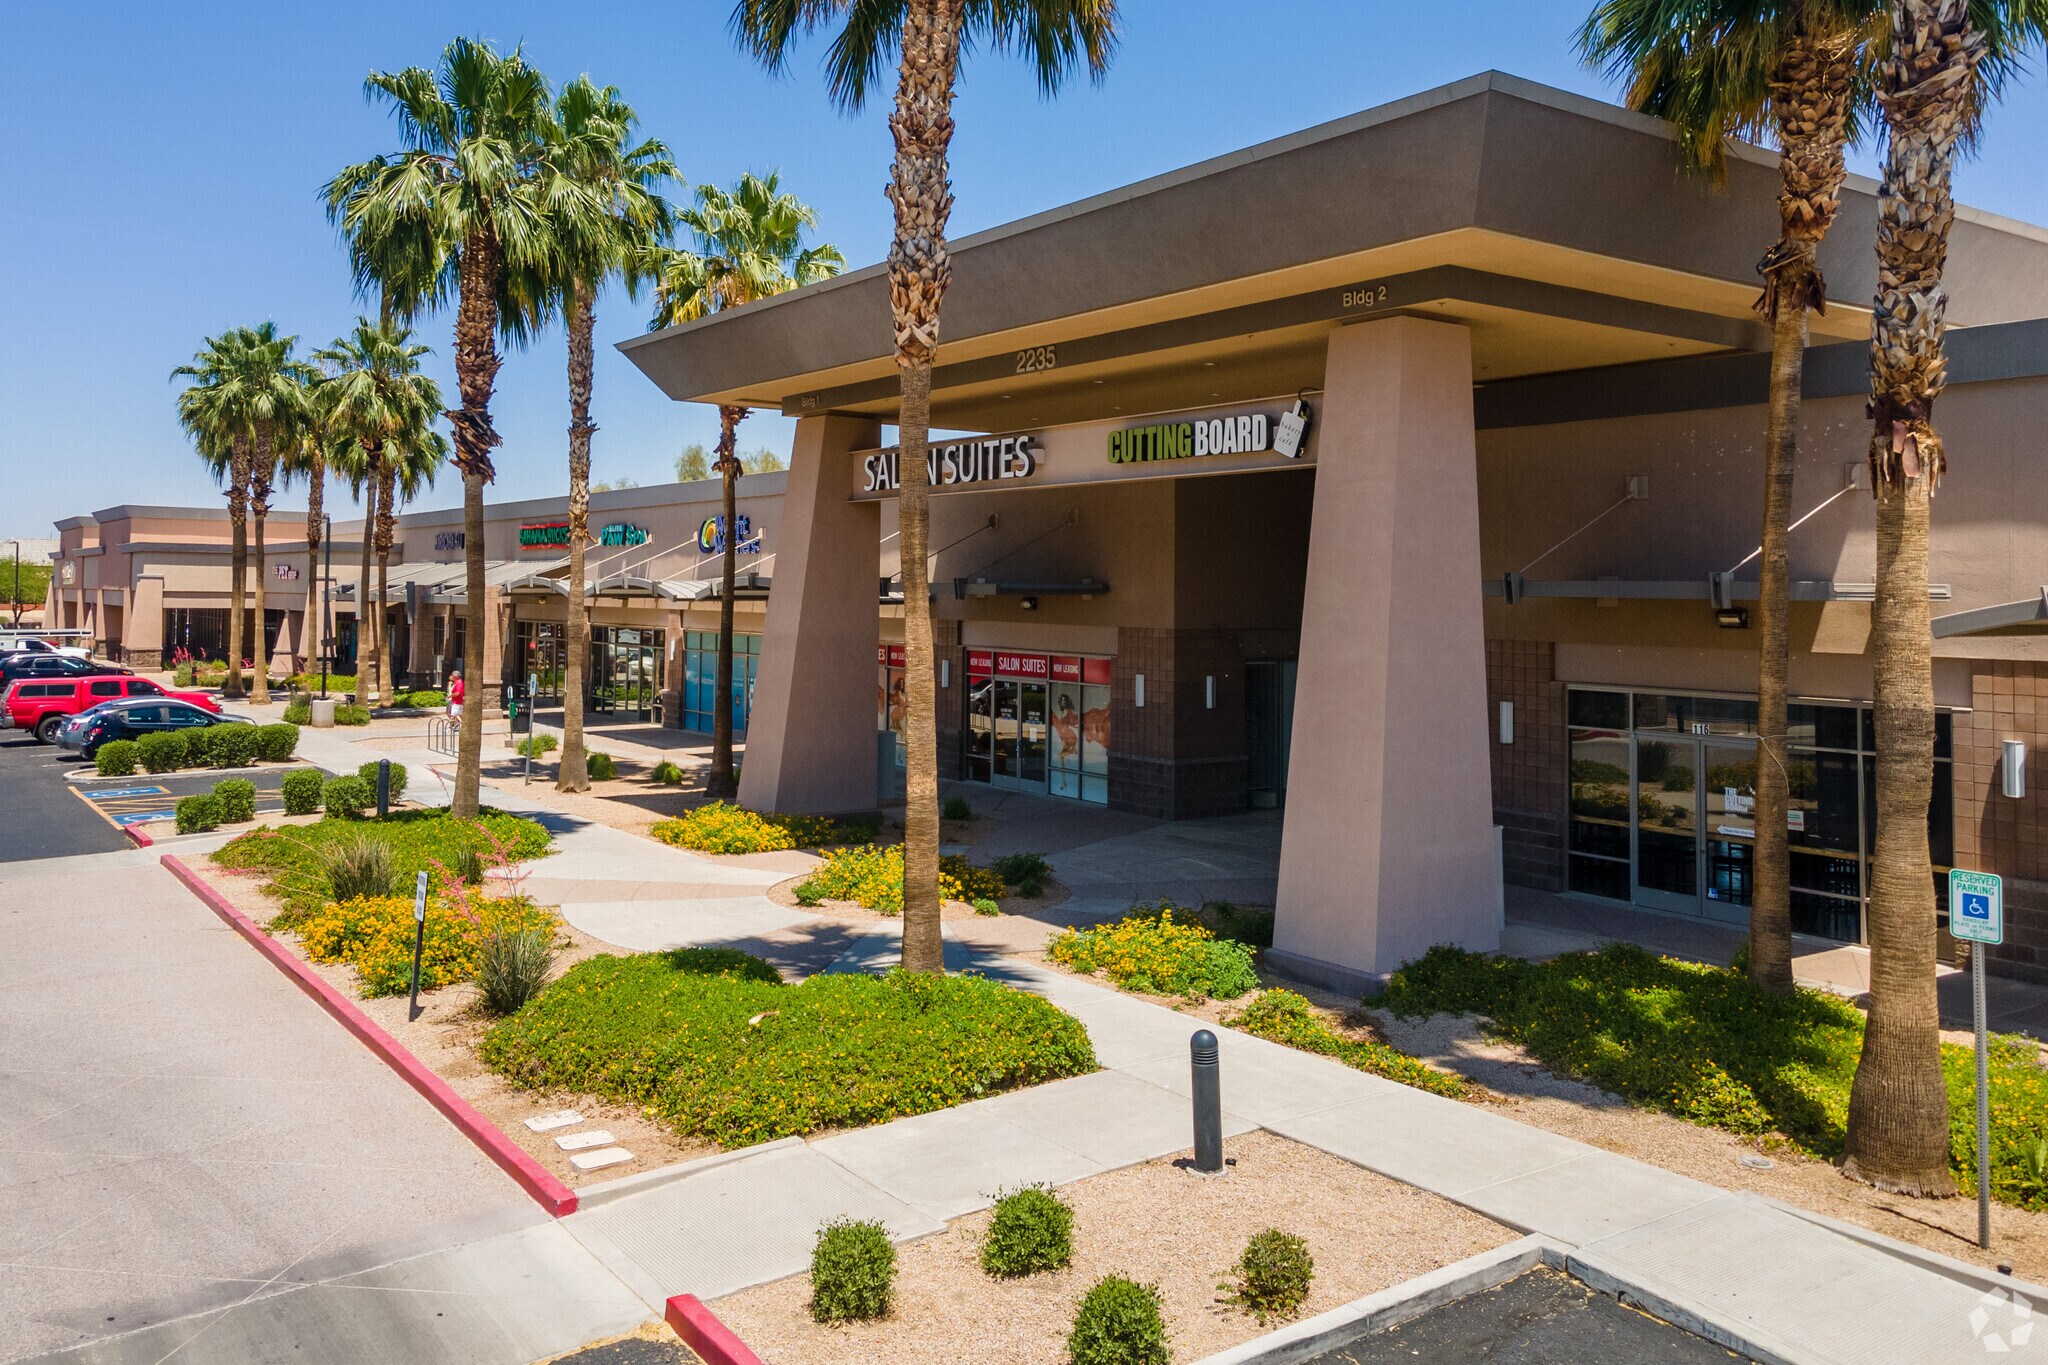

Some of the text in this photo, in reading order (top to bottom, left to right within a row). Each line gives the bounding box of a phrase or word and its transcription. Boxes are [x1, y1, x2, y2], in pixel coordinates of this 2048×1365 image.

[1343, 285, 1387, 307] Bldg 2
[1016, 345, 1057, 373] 2235
[1280, 420, 1301, 437] bakery
[1107, 413, 1268, 464] CUTTING BOARD
[1279, 437, 1294, 446] café
[863, 435, 1032, 492] SALN SUITES
[609, 525, 623, 533] ELITE
[970, 657, 978, 666] NOW
[998, 656, 1046, 673] SALON SUITES
[1053, 663, 1079, 674] NOW LEASING
[1693, 724, 1709, 735] 116
[1724, 787, 1737, 796] THE
[1724, 795, 1754, 806] CUTTING
[1953, 872, 1997, 887] RESERVED
[1956, 882, 1995, 896] PARKING
